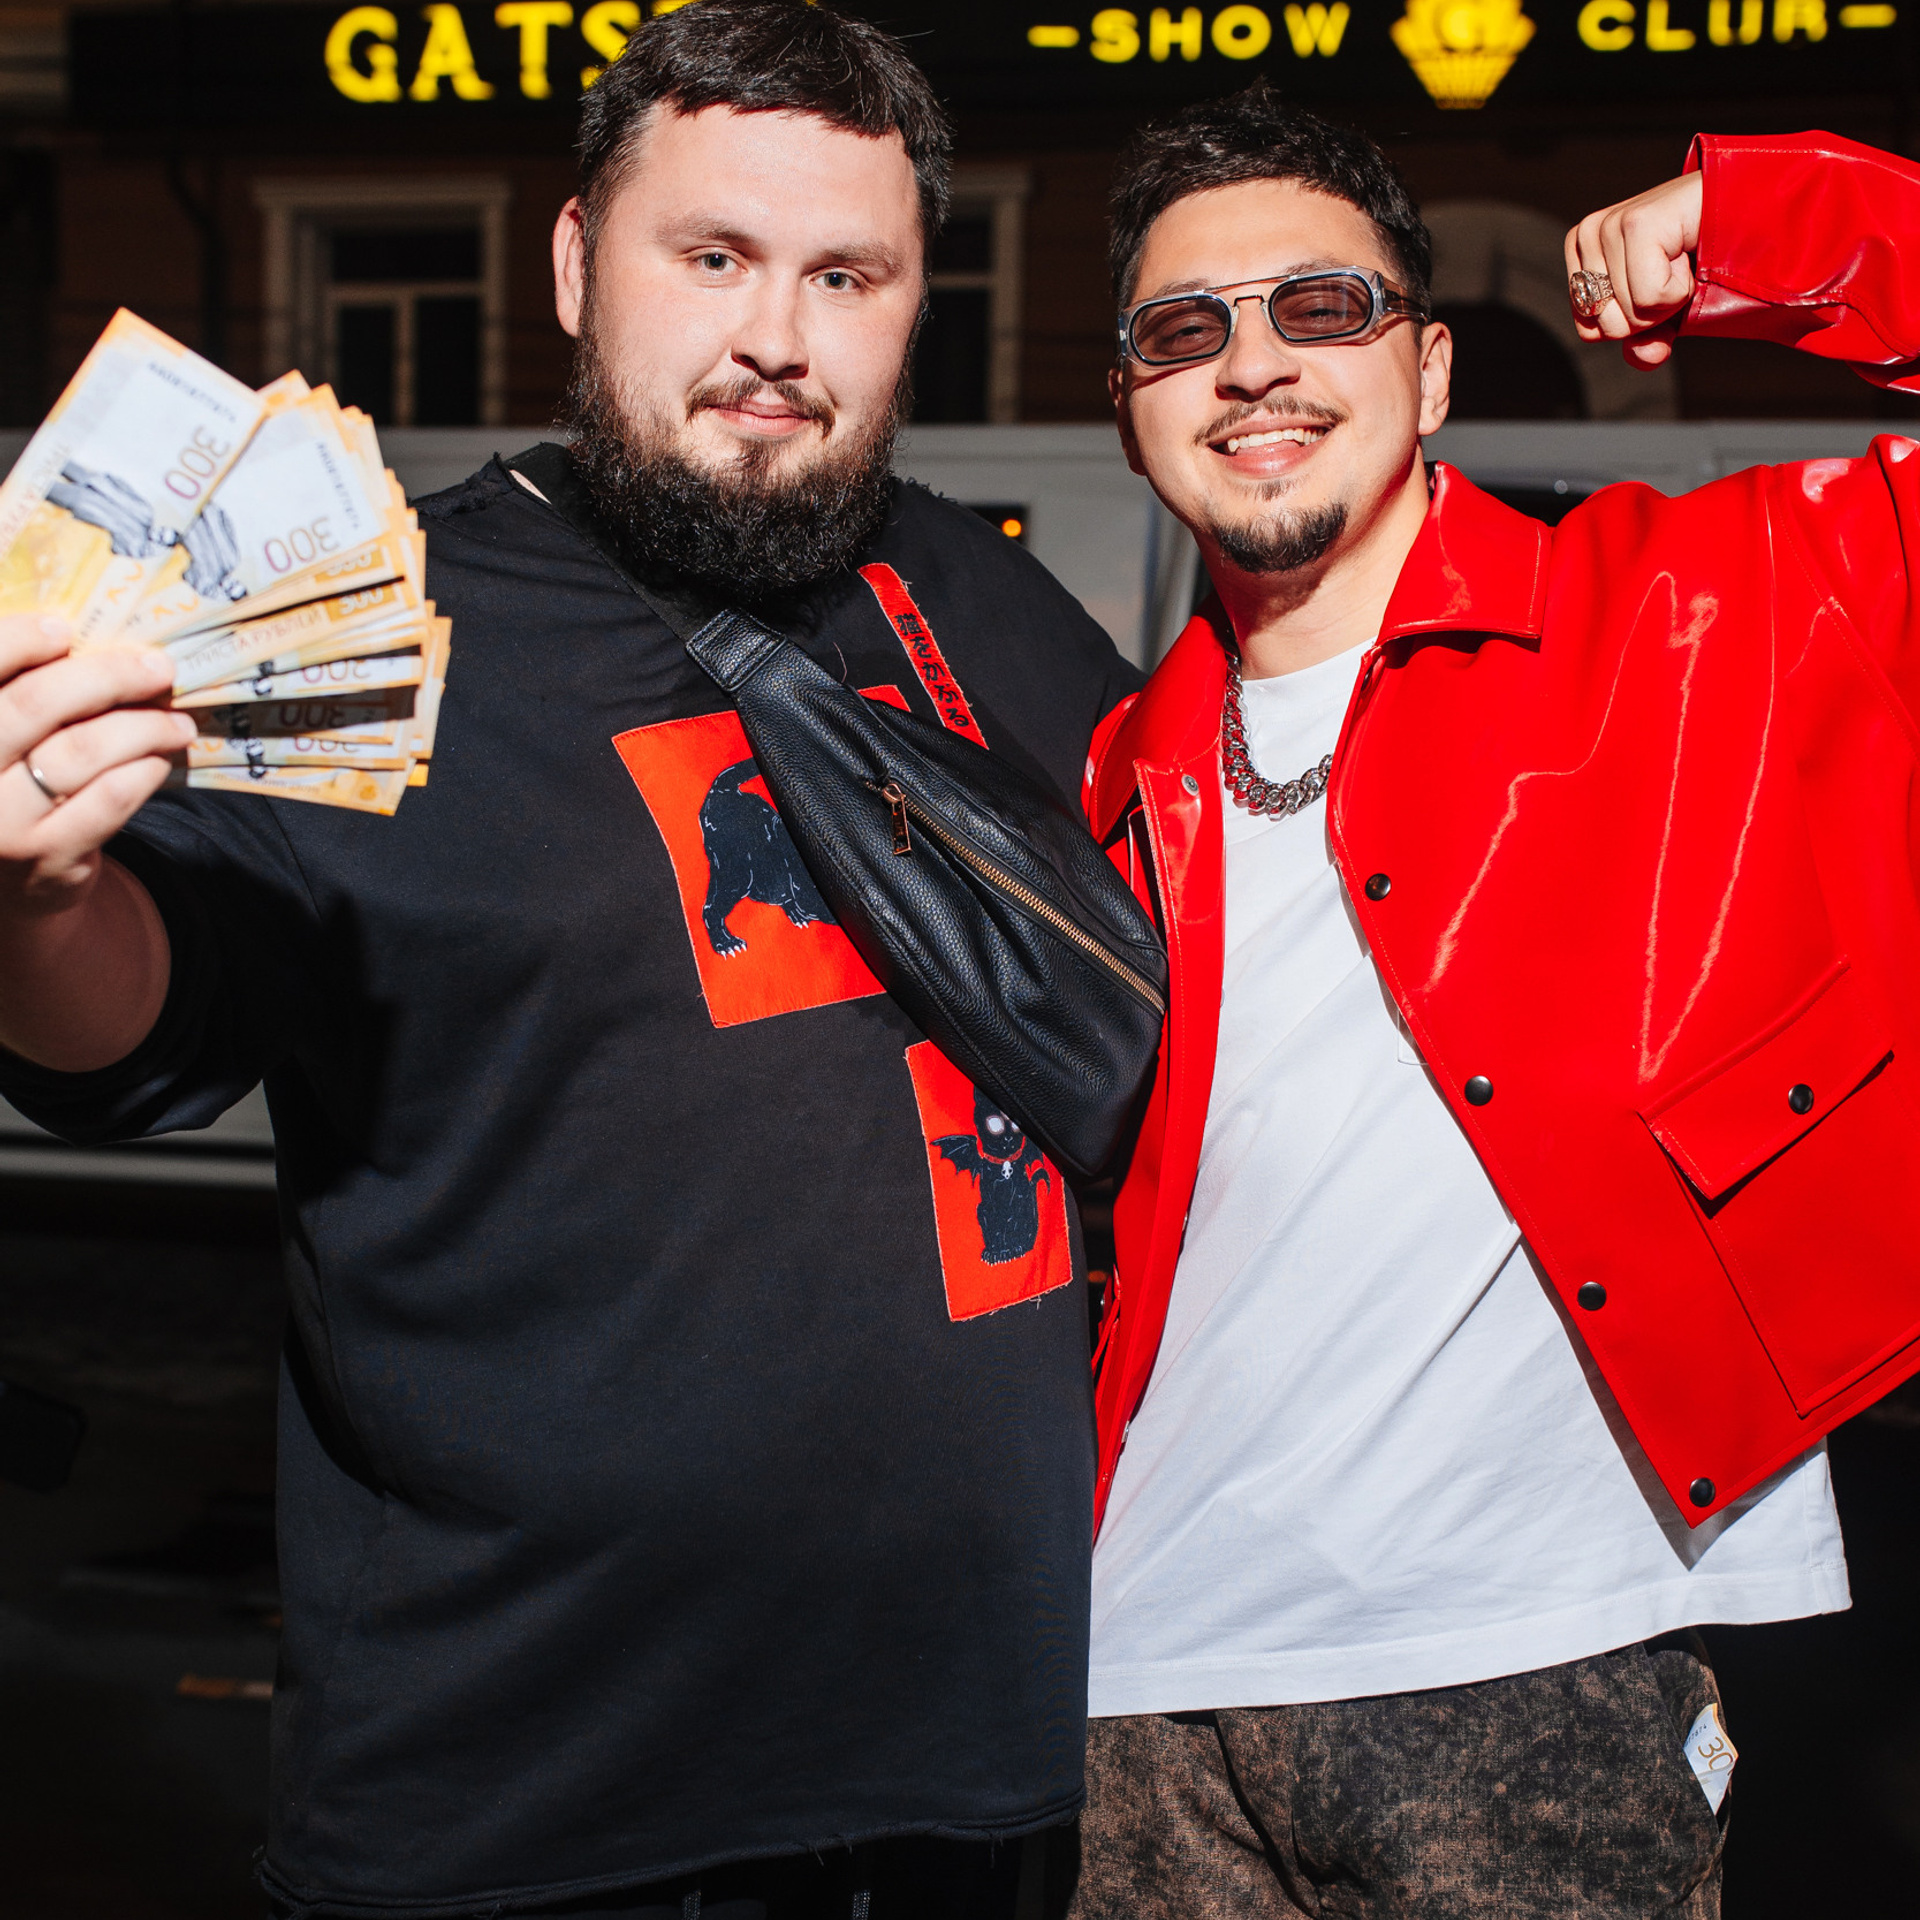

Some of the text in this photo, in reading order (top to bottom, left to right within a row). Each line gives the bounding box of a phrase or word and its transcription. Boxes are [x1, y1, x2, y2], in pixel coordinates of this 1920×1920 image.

[325, 0, 698, 101] GATS
[164, 424, 231, 500] 300
[264, 515, 341, 574] 300
[338, 586, 385, 616] 300
[894, 612, 970, 727] 猫をかぶる
[1697, 1736, 1735, 1776] 30
